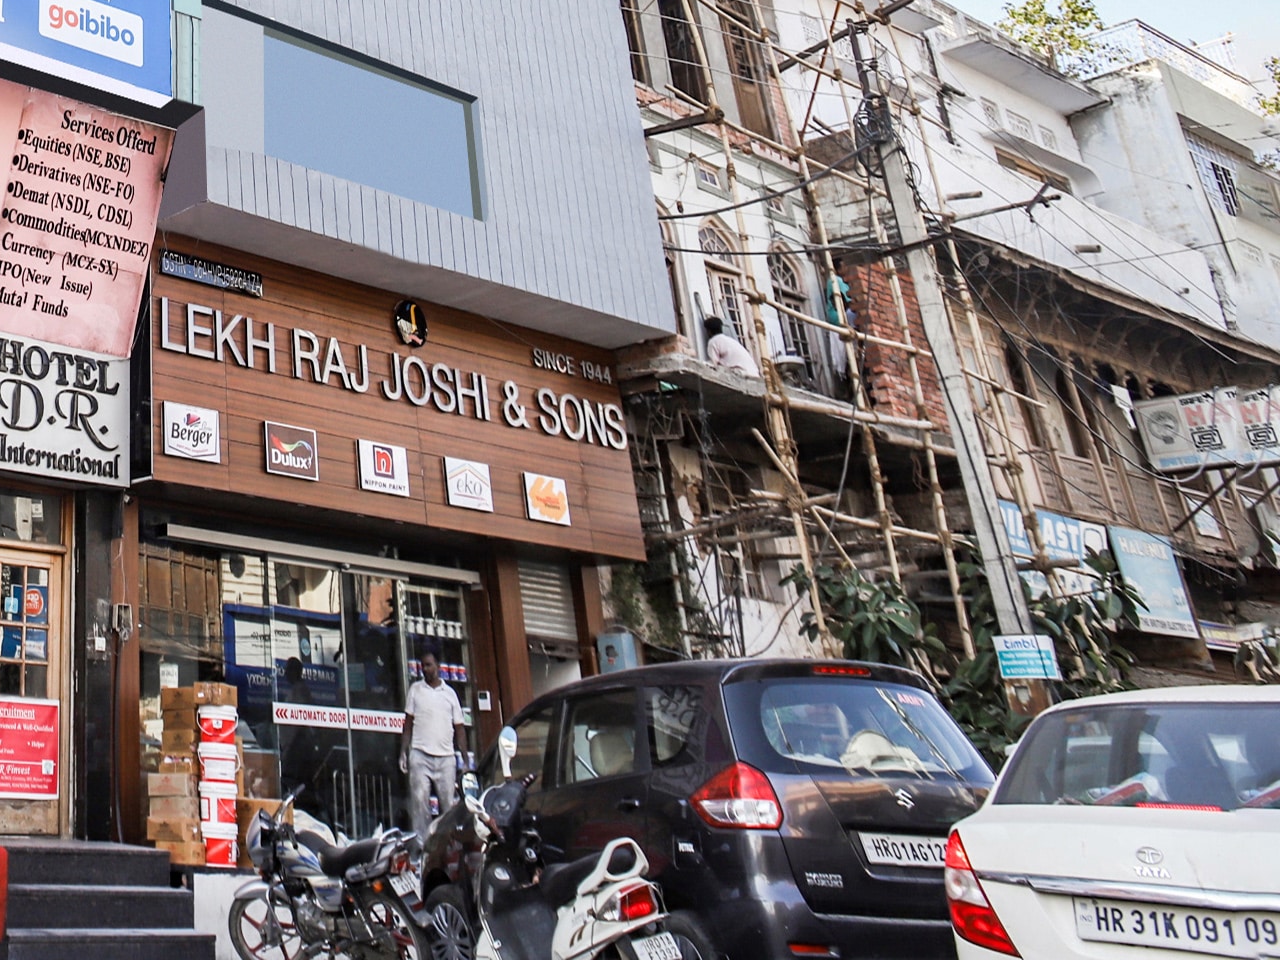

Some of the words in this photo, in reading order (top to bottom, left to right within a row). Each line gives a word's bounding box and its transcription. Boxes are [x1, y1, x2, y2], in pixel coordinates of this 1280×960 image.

[48, 4, 135, 47] goibibo
[23, 128, 72, 157] Equities
[61, 109, 114, 143] Services
[116, 126, 157, 155] Offerd
[18, 153, 82, 187] Derivatives
[82, 172, 135, 204] (NSE-FO)
[12, 181, 50, 202] Demat
[97, 203, 133, 230] CDSL)
[1, 232, 56, 265] Currency
[61, 251, 119, 280] (MCX-SX)
[60, 275, 93, 301] Issue)
[32, 289, 69, 318] Funds
[160, 296, 277, 374] LEKH
[292, 326, 370, 394] RAJ
[382, 351, 492, 422] JOSHI
[502, 379, 531, 430] &
[537, 386, 628, 450] SONS
[532, 347, 575, 375] SINCE
[579, 359, 613, 385] 1944
[171, 421, 212, 448] Berger
[271, 448, 308, 470] Dulux
[364, 479, 388, 489] NIPPON
[388, 482, 407, 492] PAINT
[290, 709, 326, 722] AUTOMATIC
[329, 712, 347, 724] DOOR
[352, 714, 387, 727] AUTOMATIC
[872, 837, 947, 863] HR01AG12
[1133, 865, 1172, 879] TATA
[1095, 906, 1125, 935] HR
